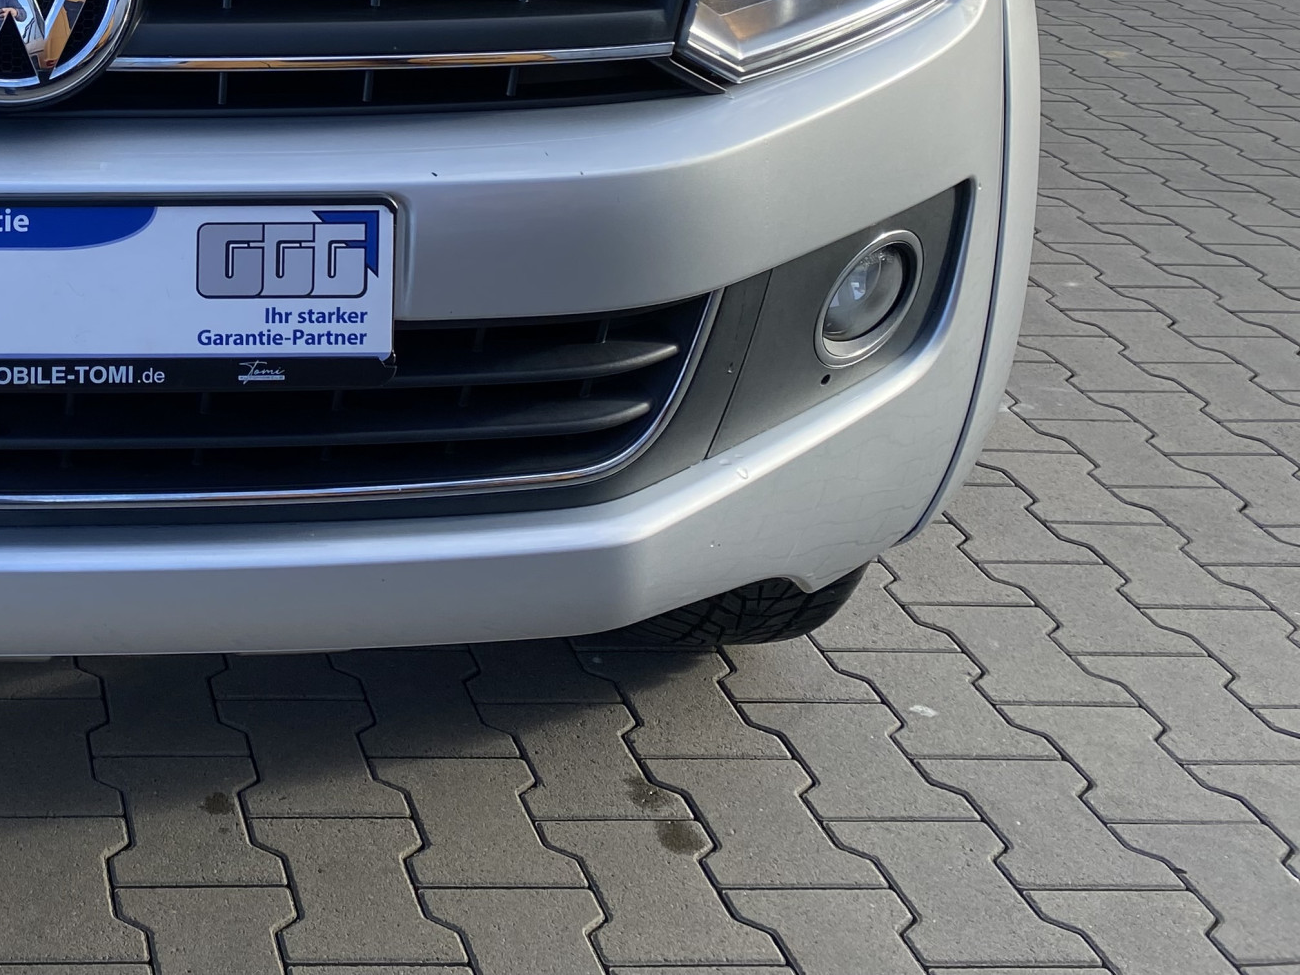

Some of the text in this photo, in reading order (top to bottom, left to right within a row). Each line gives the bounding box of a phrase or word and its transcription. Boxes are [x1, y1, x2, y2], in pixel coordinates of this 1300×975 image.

[264, 307, 368, 324] Ihr starker
[197, 329, 367, 346] Garantie-Partner
